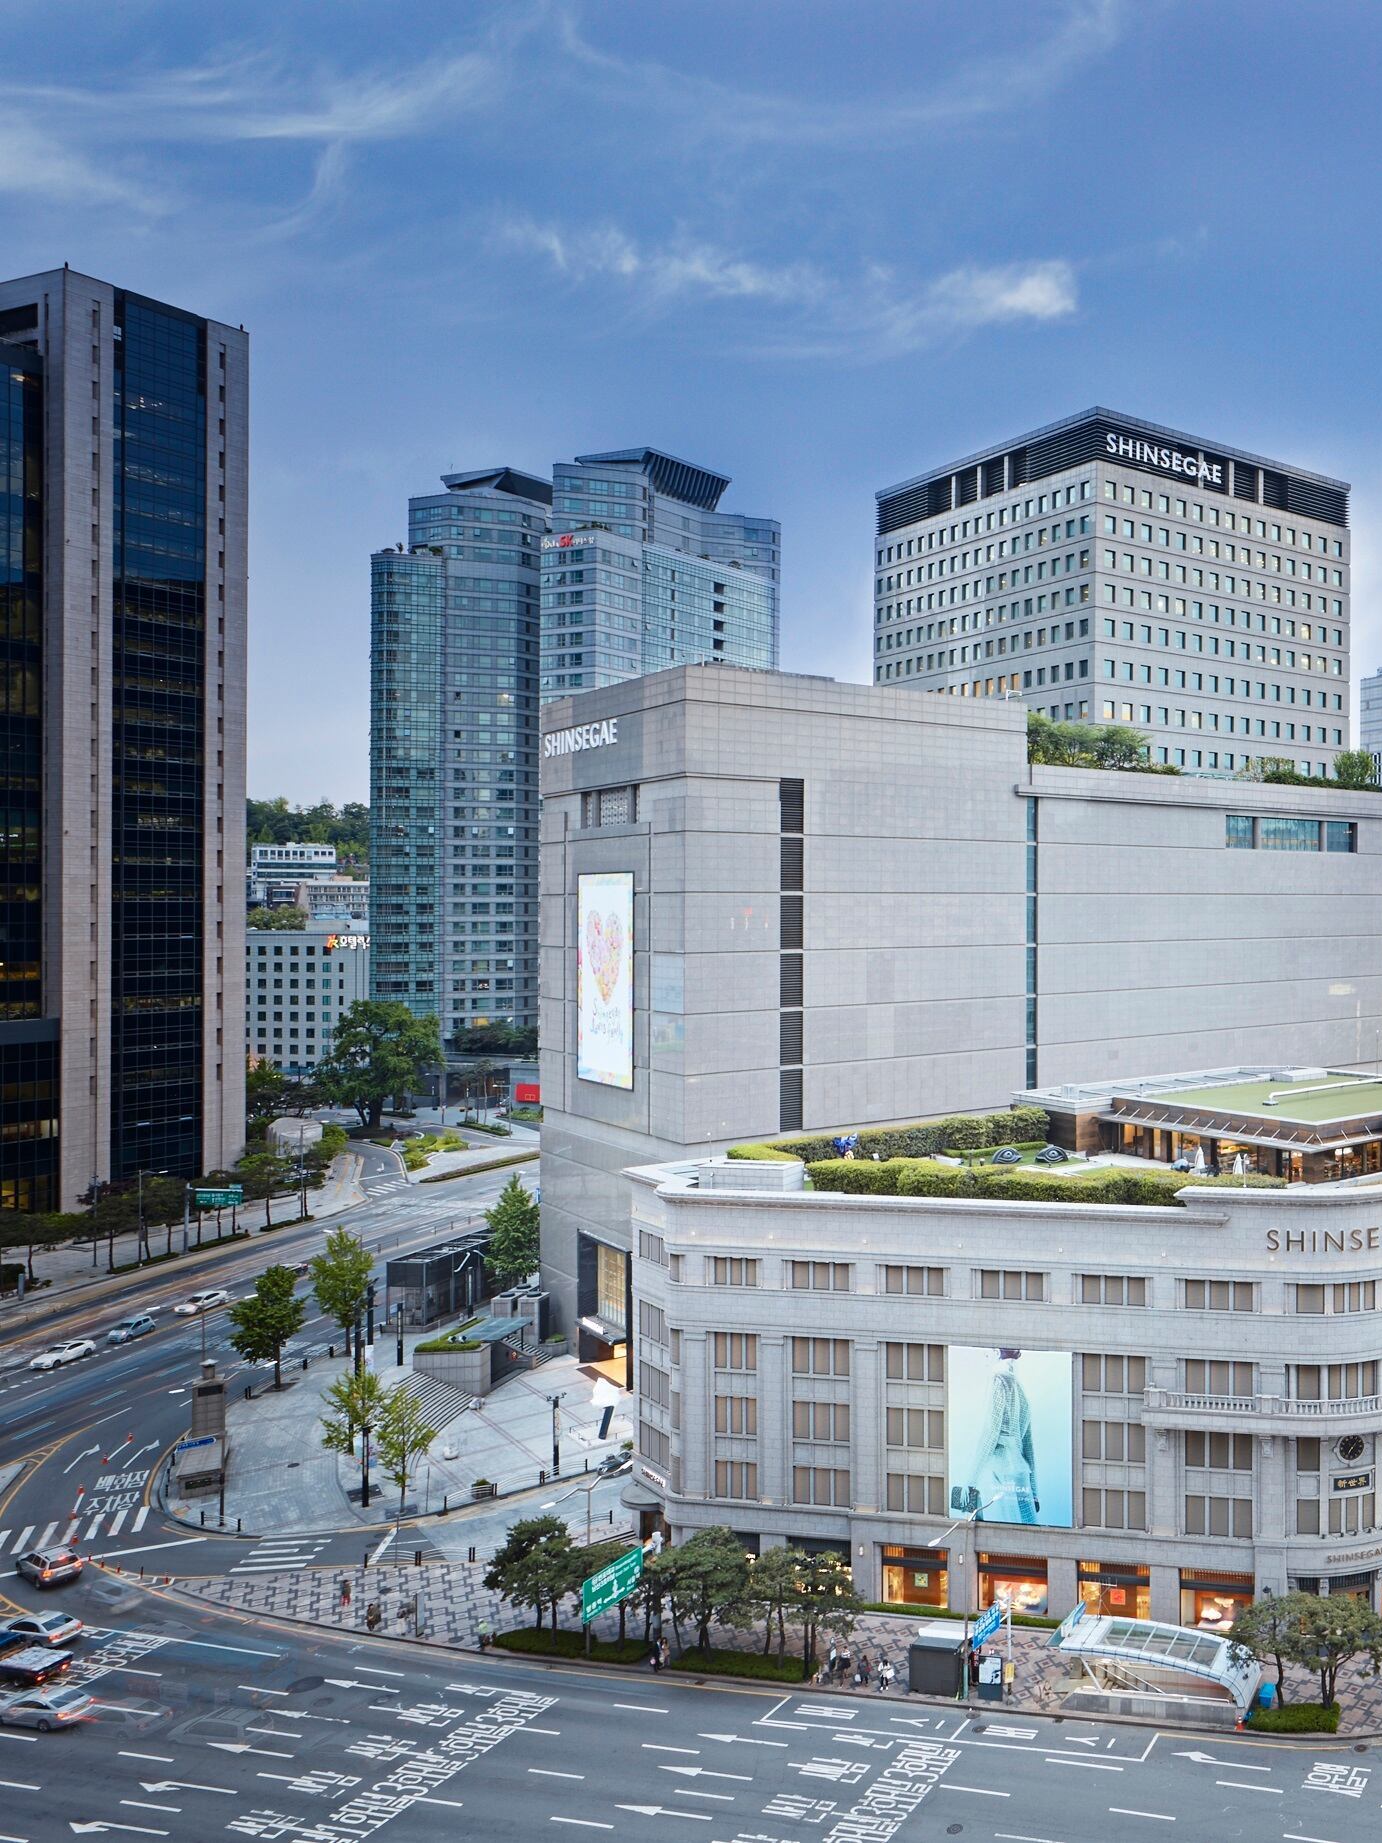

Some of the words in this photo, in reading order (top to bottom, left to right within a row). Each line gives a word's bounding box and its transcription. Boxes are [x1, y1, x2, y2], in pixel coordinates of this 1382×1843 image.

[1106, 432, 1222, 484] SHINSEGAE
[544, 719, 618, 758] SHINSEGAE
[93, 1470, 150, 1491] 백화점
[1337, 1476, 1367, 1489] 新世界
[84, 1491, 141, 1516] 주차장
[1303, 1762, 1372, 1798] 서울역
